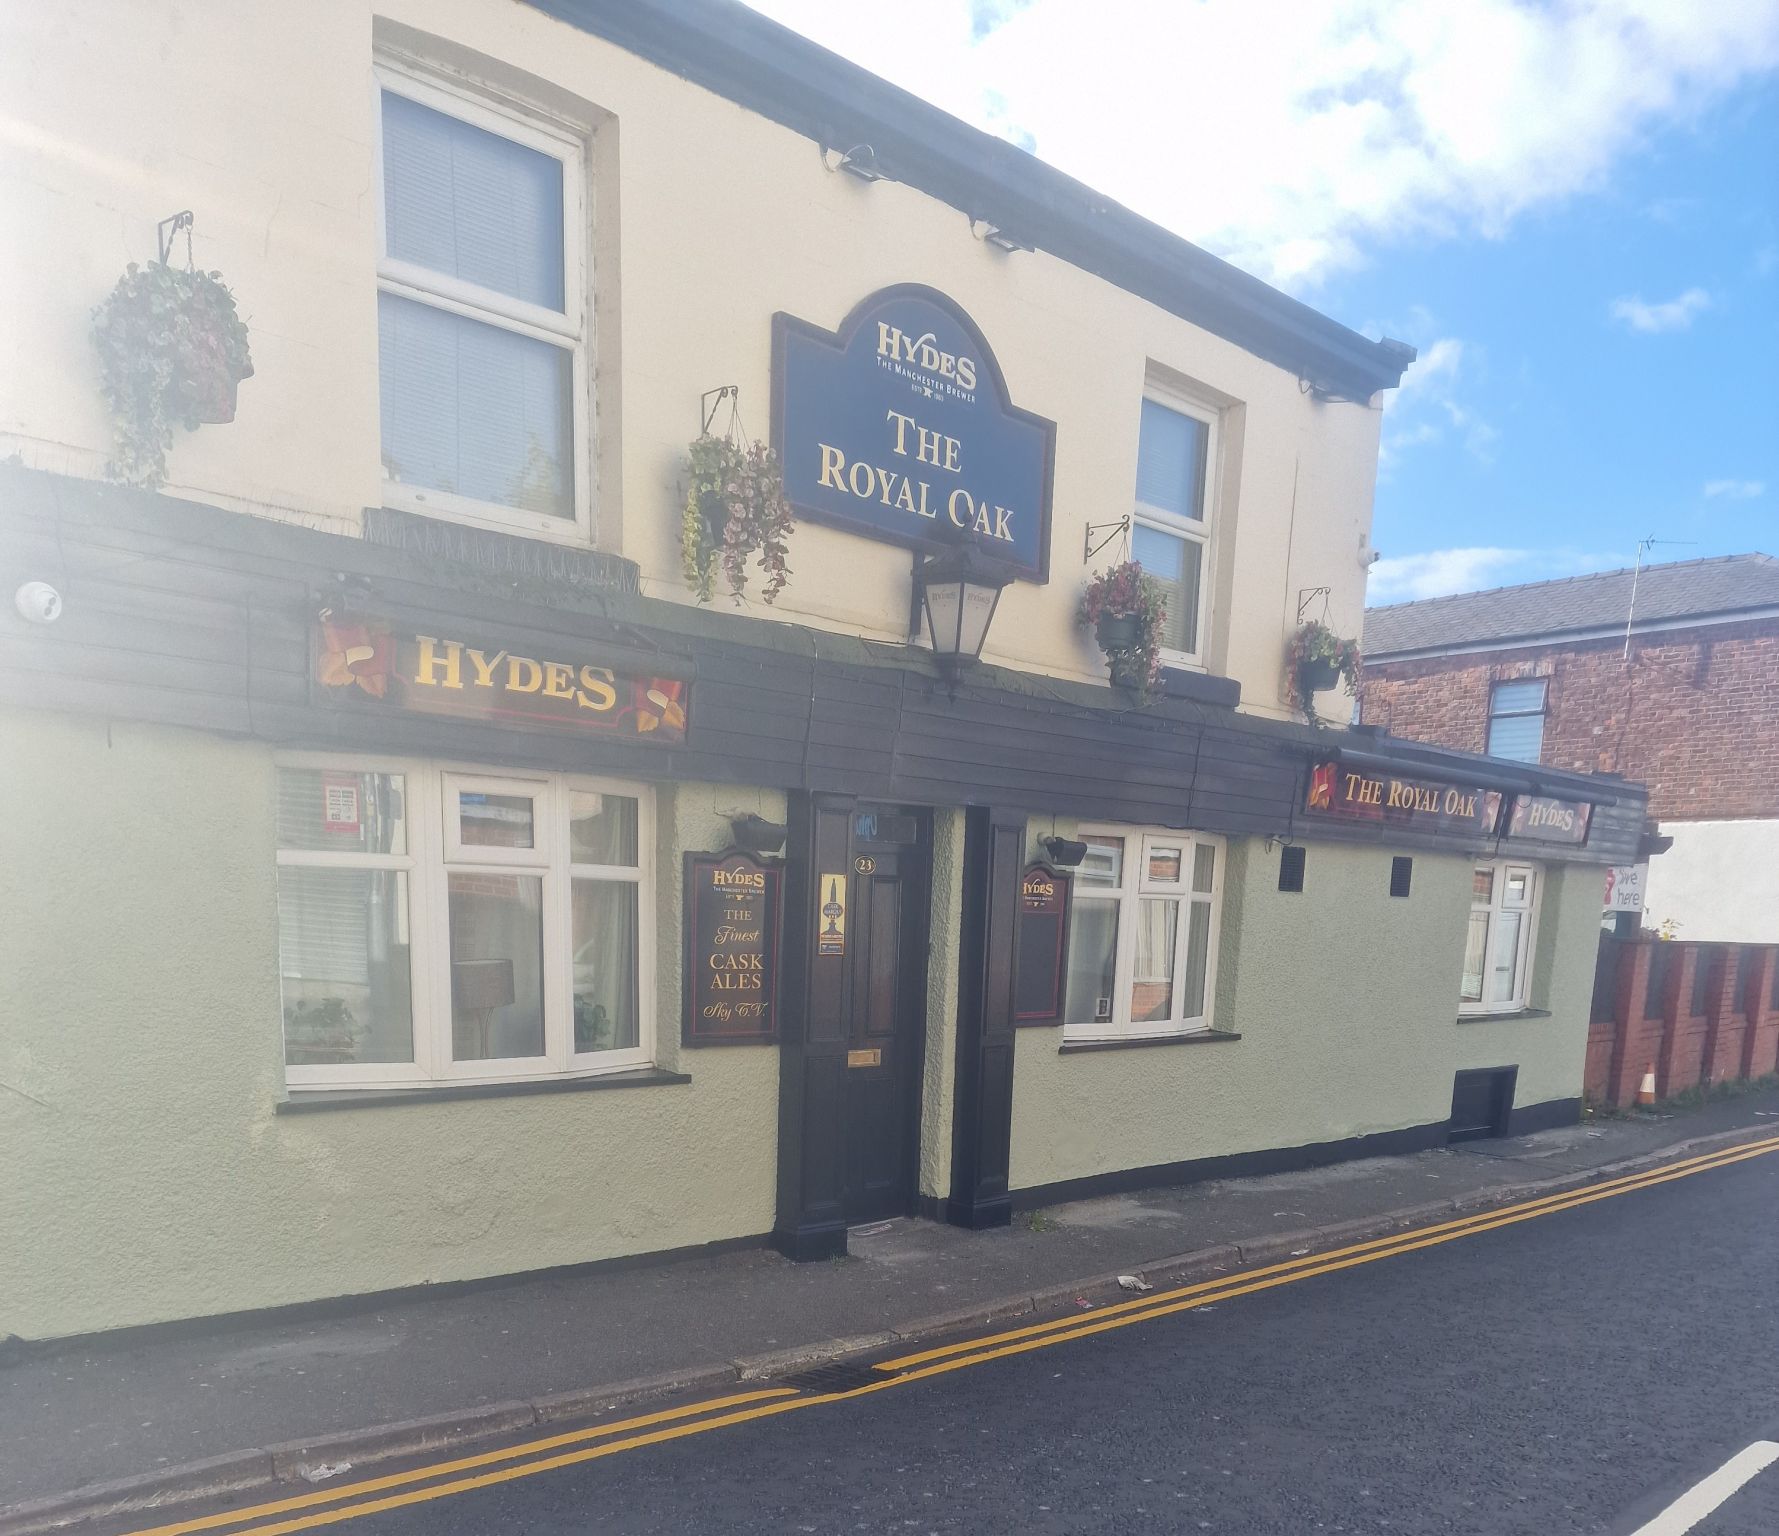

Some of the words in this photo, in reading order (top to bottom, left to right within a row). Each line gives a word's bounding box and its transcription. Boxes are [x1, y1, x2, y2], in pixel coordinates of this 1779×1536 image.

[877, 321, 977, 391] HYDES
[876, 356, 892, 371] THE
[894, 363, 944, 391] MANCHESTER
[946, 384, 976, 404] BREWER
[886, 409, 962, 473] THE
[816, 443, 938, 519] ROYAL
[948, 489, 1015, 542] OAK
[414, 634, 617, 711] HYDES
[1345, 773, 1383, 806] THE
[1386, 780, 1440, 813] ROYAL
[1444, 789, 1478, 818] OAK
[1528, 801, 1575, 832] HYDES
[859, 859, 872, 871] 23
[712, 866, 765, 888] HYDES
[1617, 888, 1641, 906] here
[723, 909, 752, 921] THE
[714, 925, 761, 945] Finest
[709, 953, 765, 970] CASK
[710, 973, 762, 989] ALES
[703, 1001, 732, 1022] Sky
